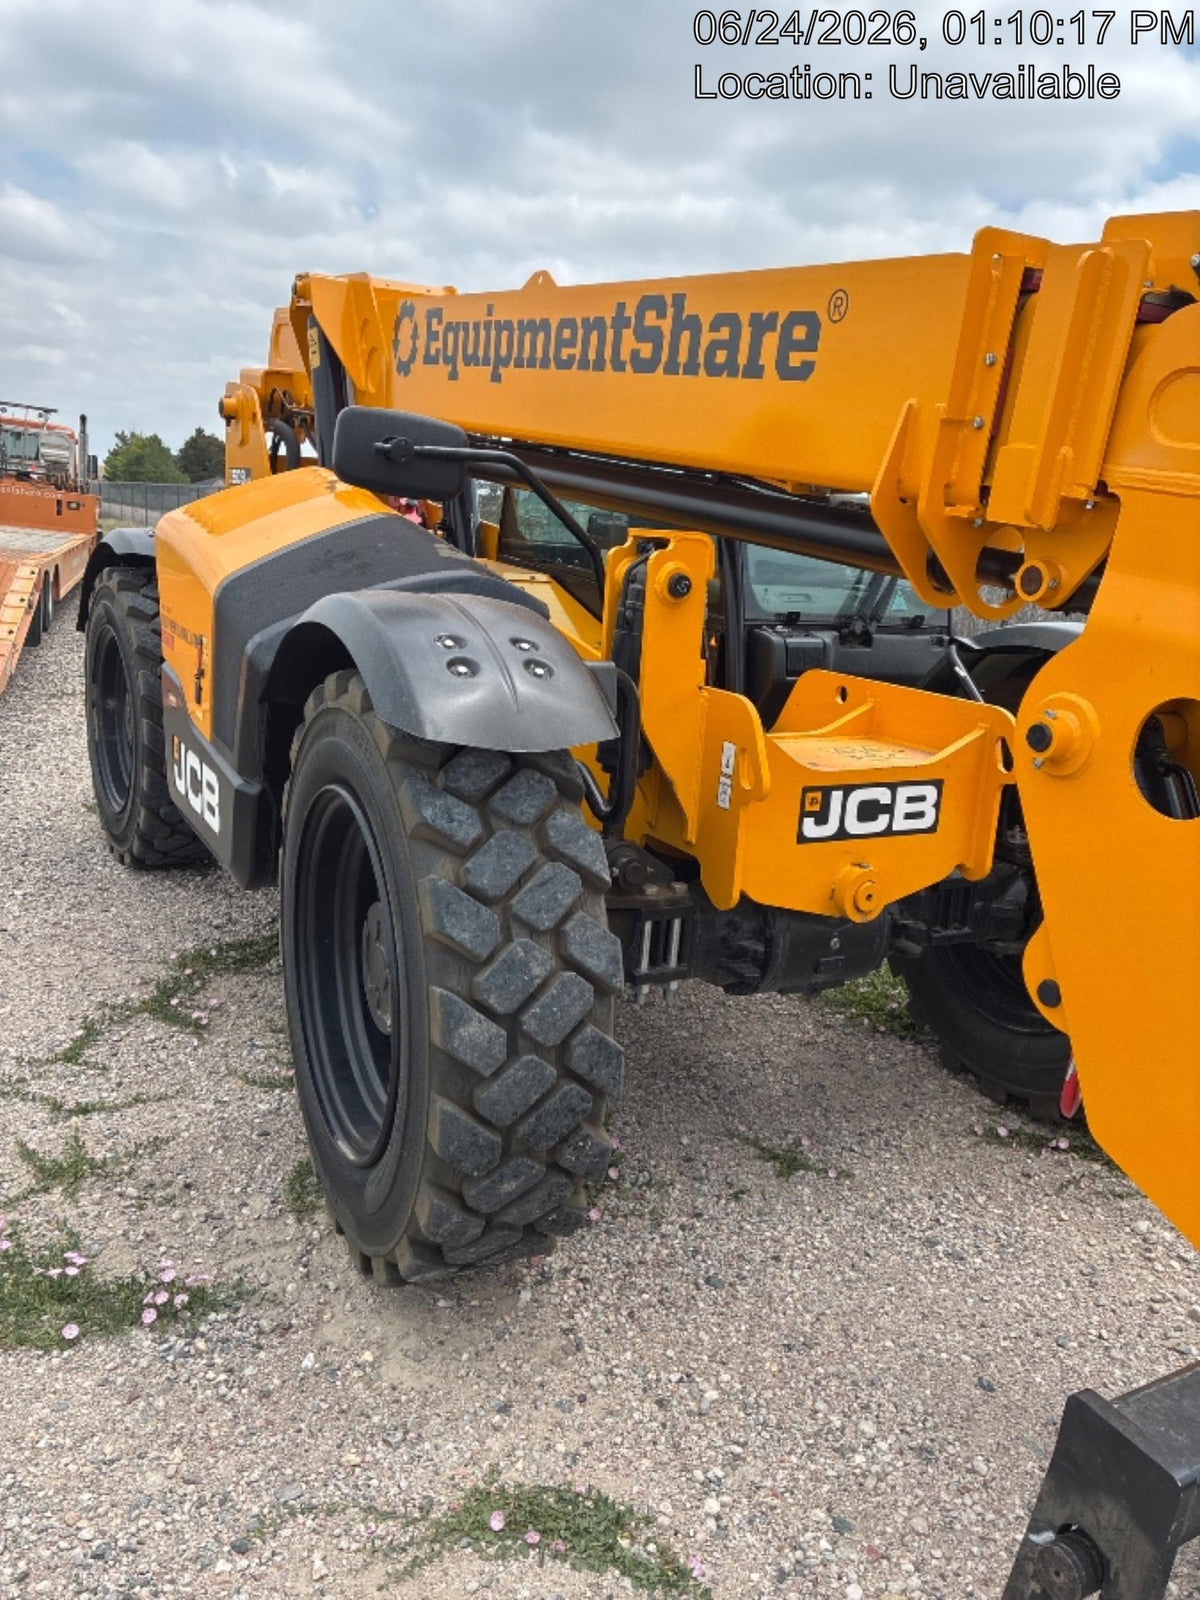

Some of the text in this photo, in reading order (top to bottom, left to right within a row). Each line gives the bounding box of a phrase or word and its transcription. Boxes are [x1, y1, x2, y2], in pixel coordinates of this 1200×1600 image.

[423, 293, 822, 382] EquipmentShare
[173, 742, 220, 833] JCB
[802, 785, 938, 838] JCB
